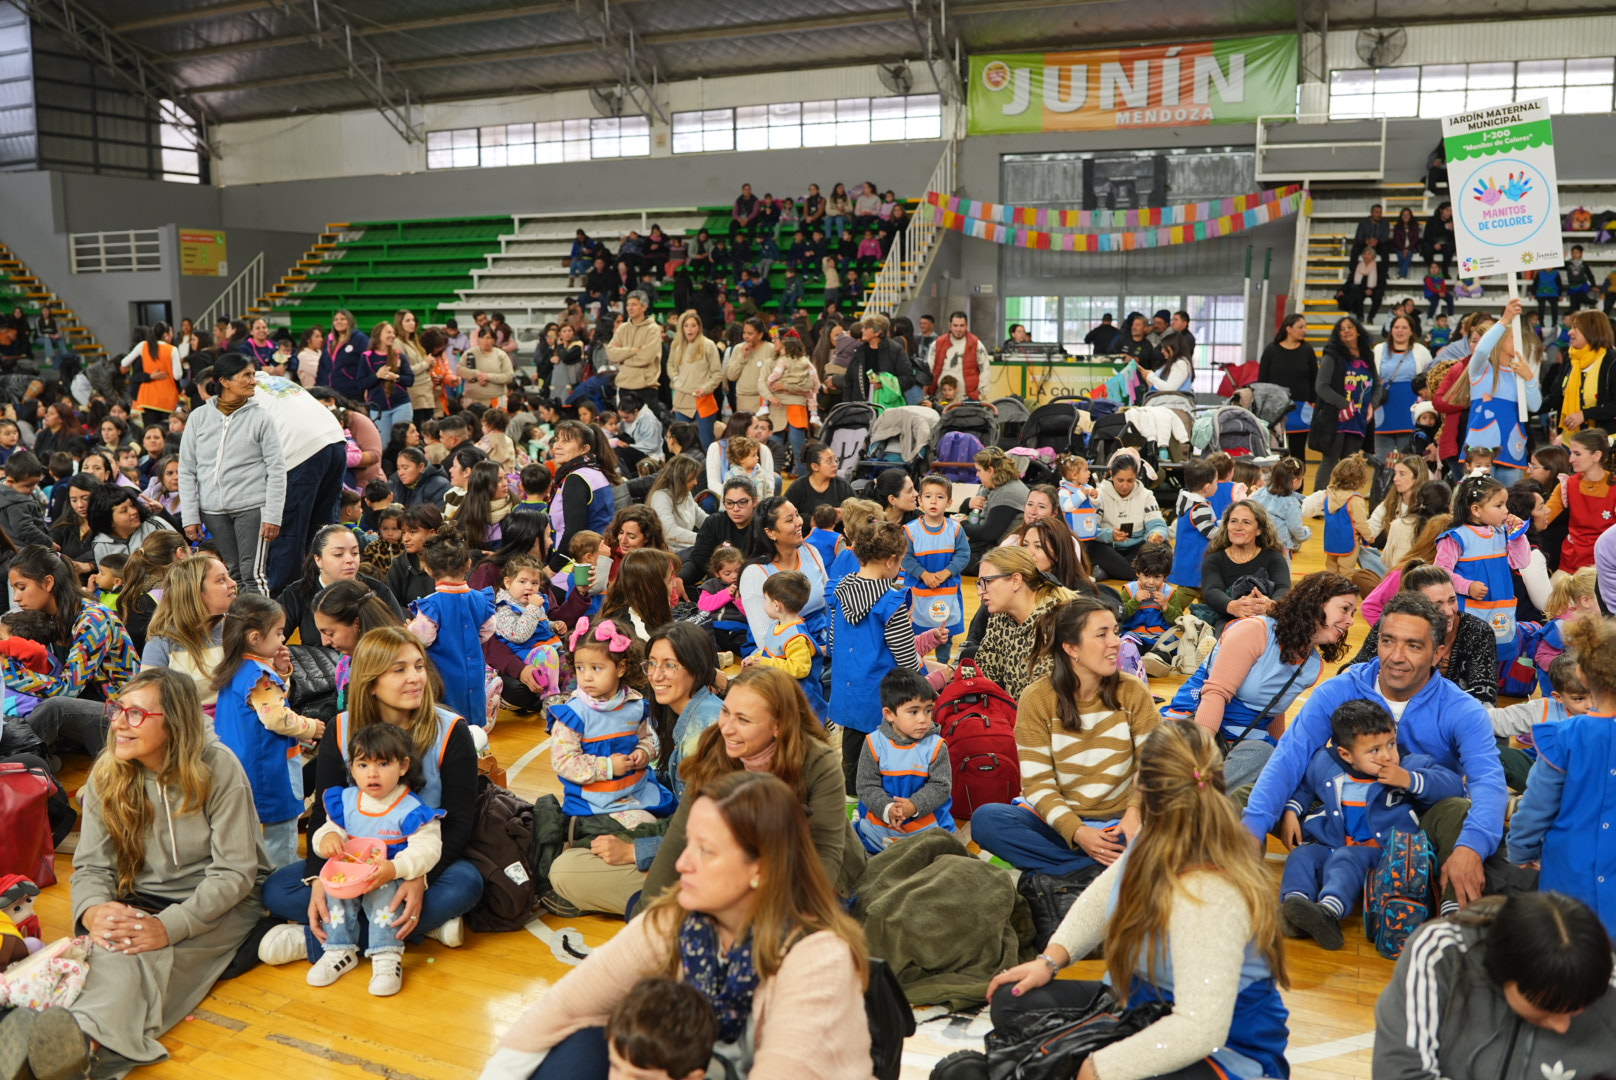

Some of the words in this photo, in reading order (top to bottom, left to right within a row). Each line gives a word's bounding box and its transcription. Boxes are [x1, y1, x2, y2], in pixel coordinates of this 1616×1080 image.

[1002, 46, 1246, 116] JUNÍN
[1115, 106, 1215, 125] MENDOZA
[1449, 111, 1484, 126] JARDÍN
[1486, 101, 1541, 119] MATERNAL
[1468, 114, 1523, 130] MUNICIPAL
[1482, 129, 1511, 141] J-200
[1482, 205, 1526, 219] MANITOS
[1478, 221, 1490, 231] DE
[1491, 215, 1533, 229] COLORES
[1029, 387, 1046, 396] LA
